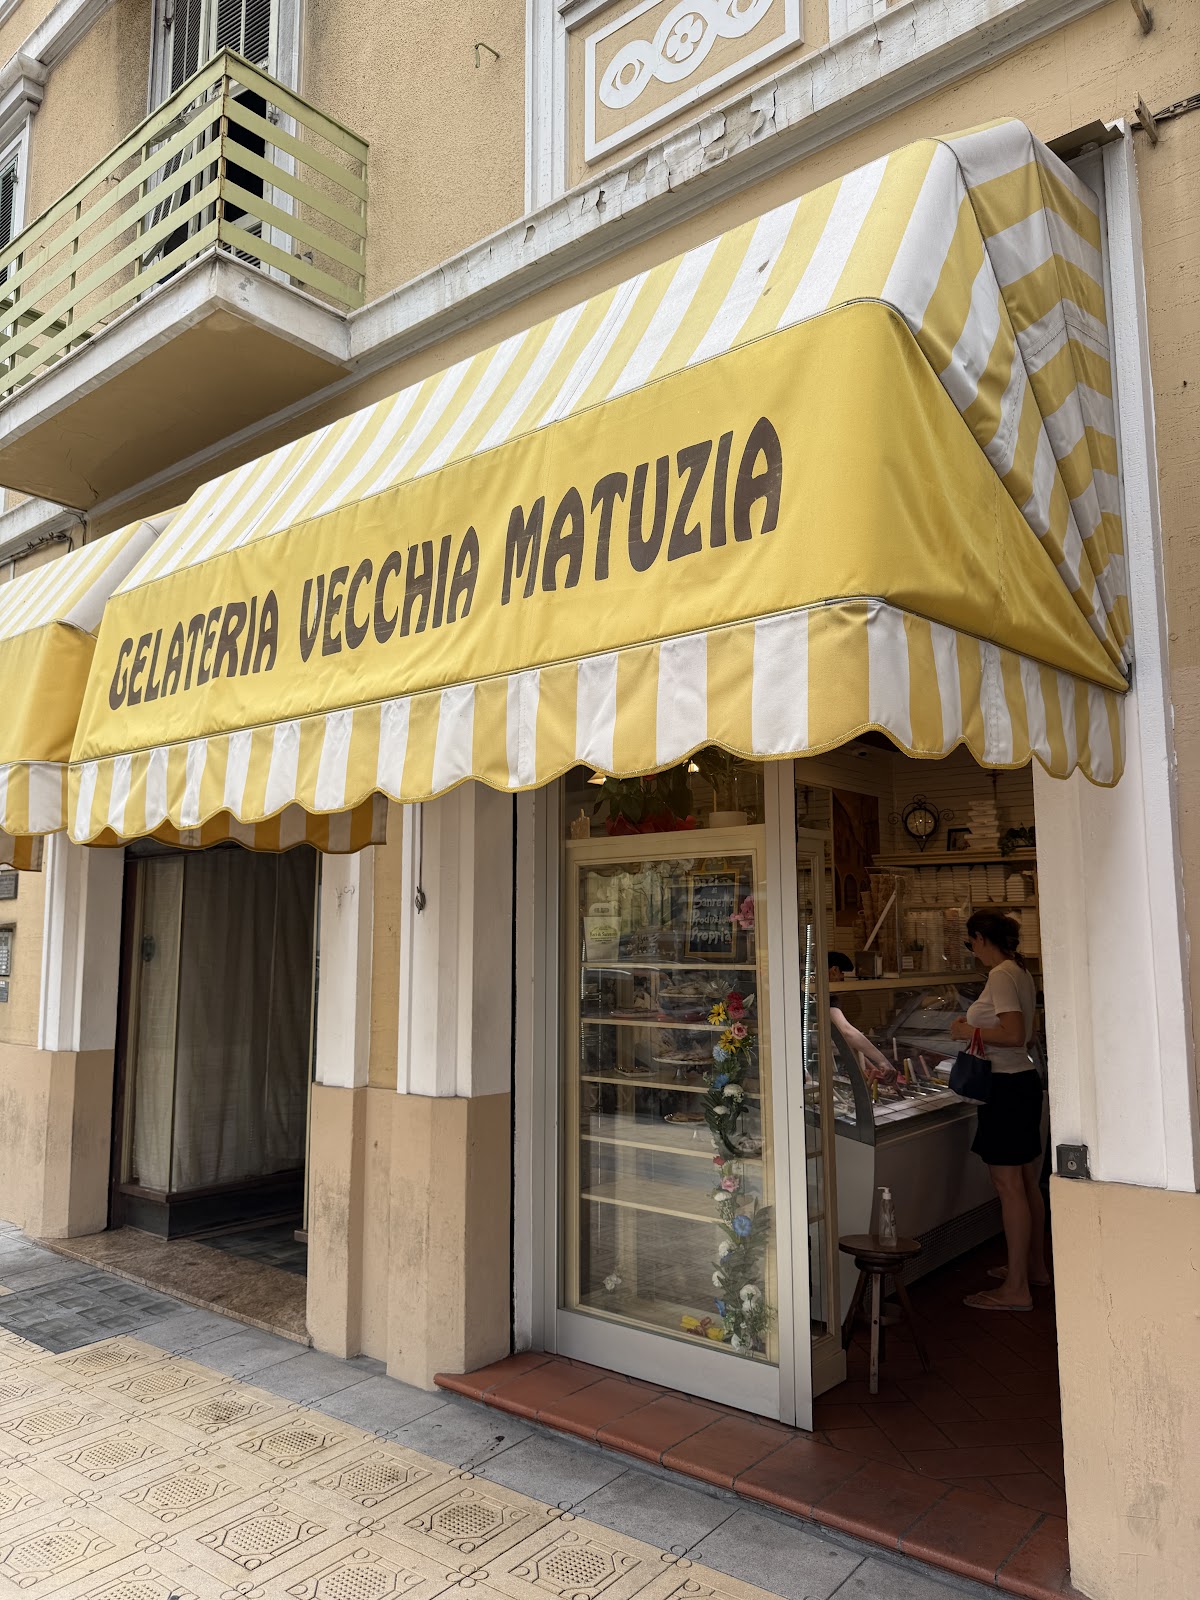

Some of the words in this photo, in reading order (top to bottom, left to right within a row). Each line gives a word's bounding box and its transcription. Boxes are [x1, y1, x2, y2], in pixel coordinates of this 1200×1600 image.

[108, 589, 279, 711] GELATERIA
[300, 526, 480, 663] VECCHIA
[501, 416, 783, 606] MATUZIA
[691, 927, 732, 944] Propria
